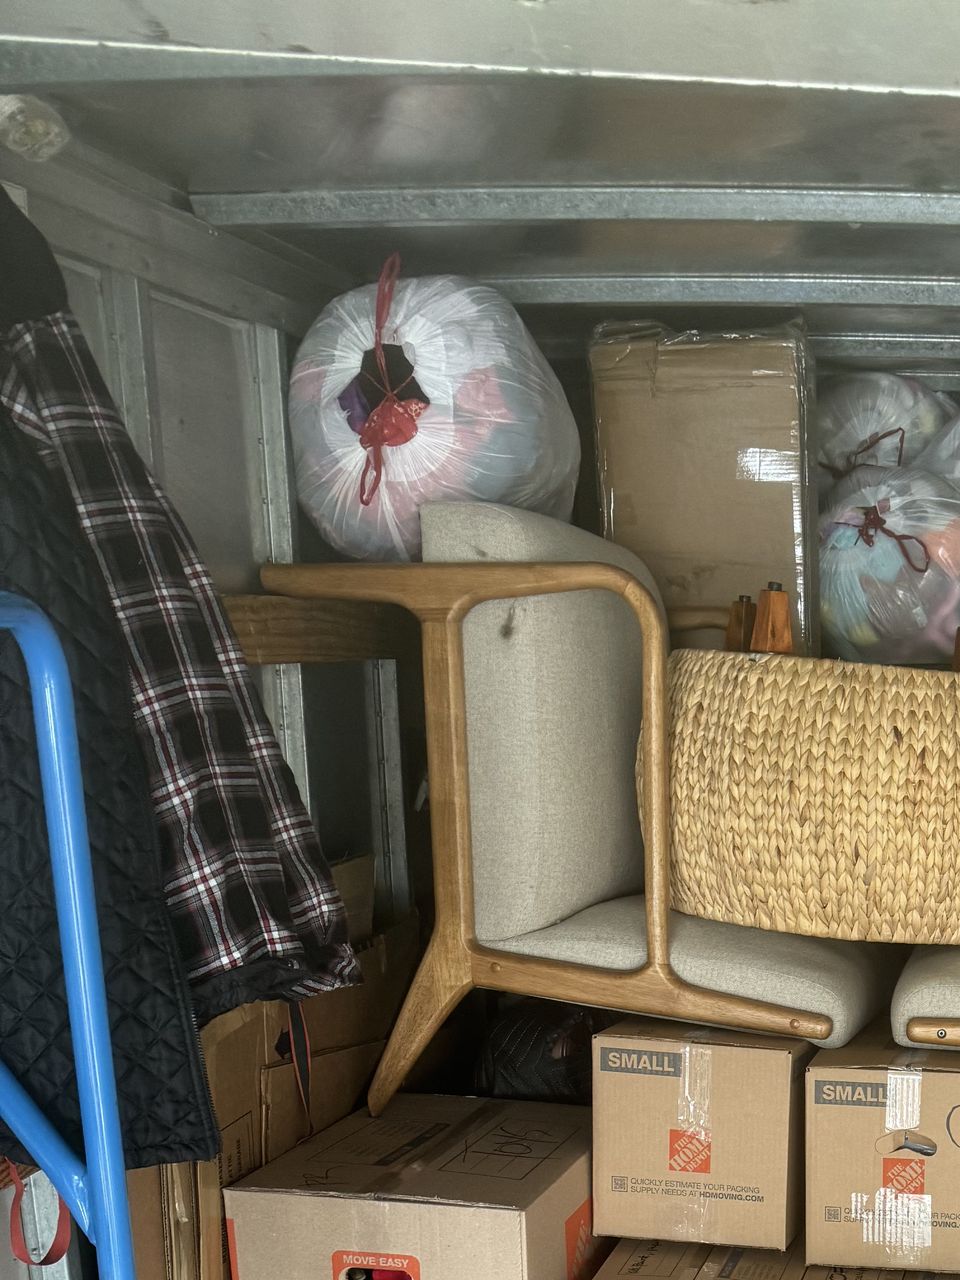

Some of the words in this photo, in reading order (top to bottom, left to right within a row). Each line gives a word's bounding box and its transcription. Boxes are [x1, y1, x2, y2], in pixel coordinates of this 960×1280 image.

[608, 1052, 674, 1072] SMALL
[822, 1085, 887, 1102] SMALL
[631, 1177, 664, 1187] QUICKLY
[665, 1180, 701, 1189] ESTIMATE
[702, 1183, 725, 1191] YOUR
[726, 1185, 760, 1194] PACKING
[631, 1186, 660, 1194] SUPPLY
[662, 1188, 687, 1196] NEEDS
[699, 1191, 764, 1203] HDMOVING.COM
[343, 1255, 376, 1265] MOVE
[380, 1257, 409, 1268] EASY
